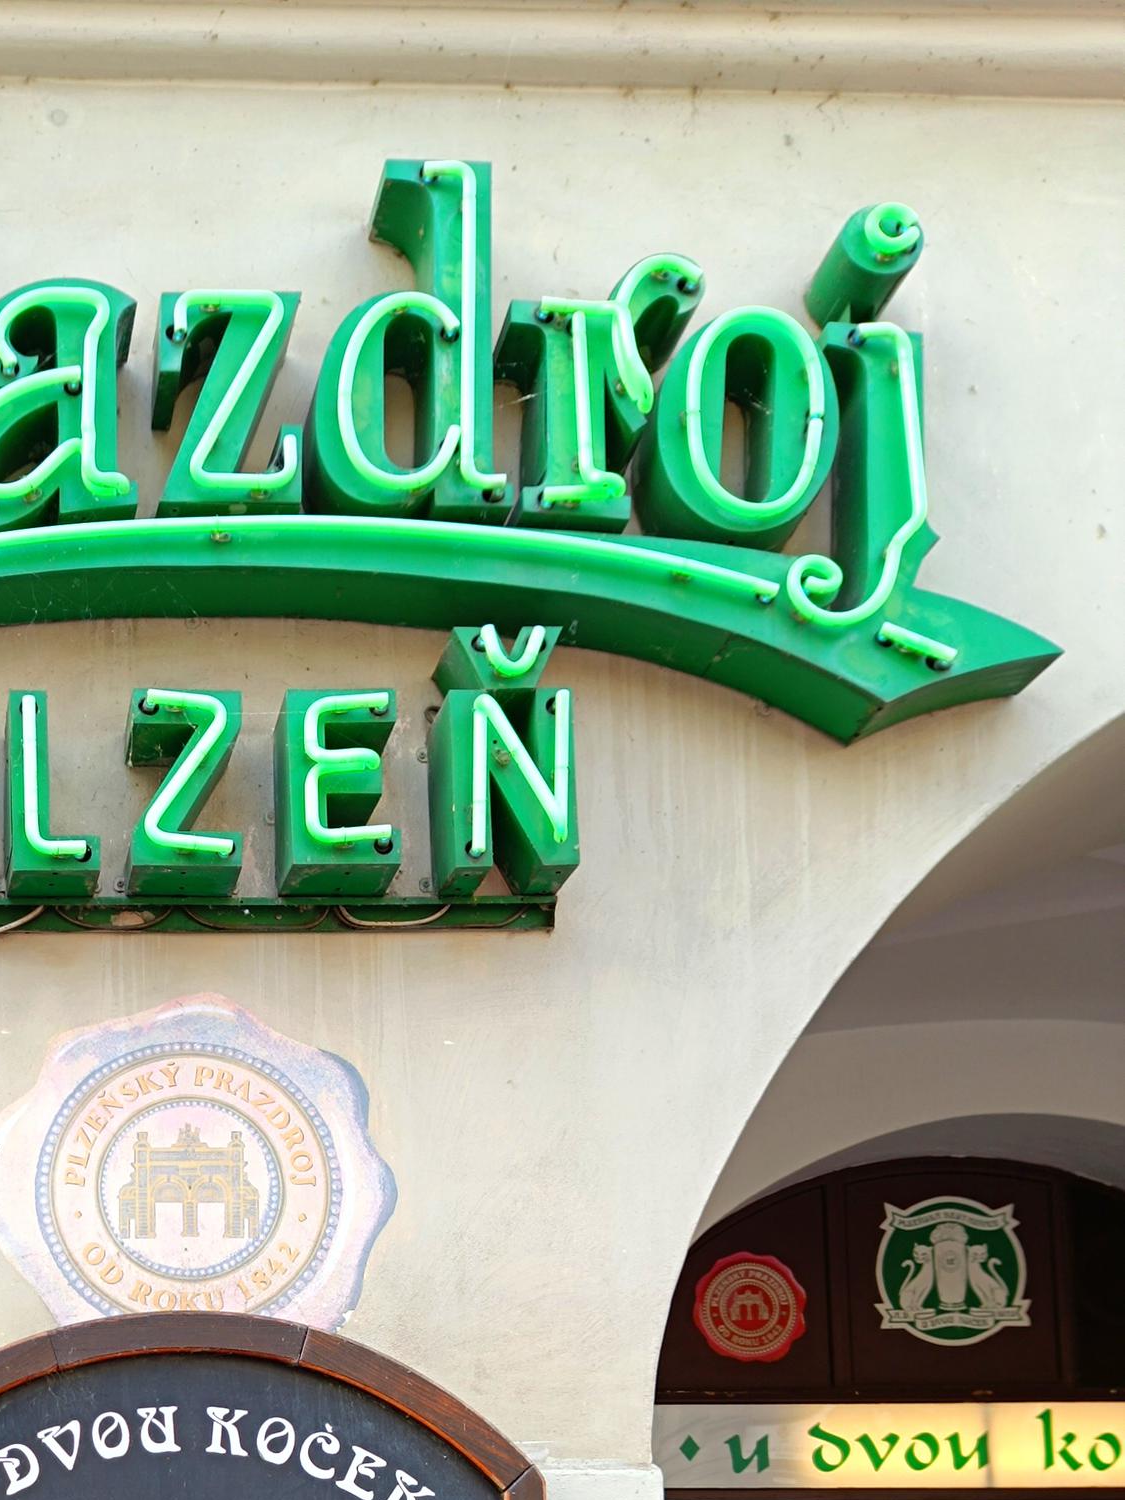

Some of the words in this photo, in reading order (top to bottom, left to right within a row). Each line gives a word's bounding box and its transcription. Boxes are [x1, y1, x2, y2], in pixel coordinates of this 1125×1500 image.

[63, 1062, 181, 1188] PLZEŇSKÝ
[193, 1065, 317, 1188] PRAZDROJ
[82, 1241, 124, 1286] OD
[127, 1280, 225, 1313] ROKU
[236, 1240, 301, 1301] 1842
[724, 1433, 770, 1475] u
[807, 1422, 989, 1473] dvou
[1035, 1408, 1123, 1472] ko
